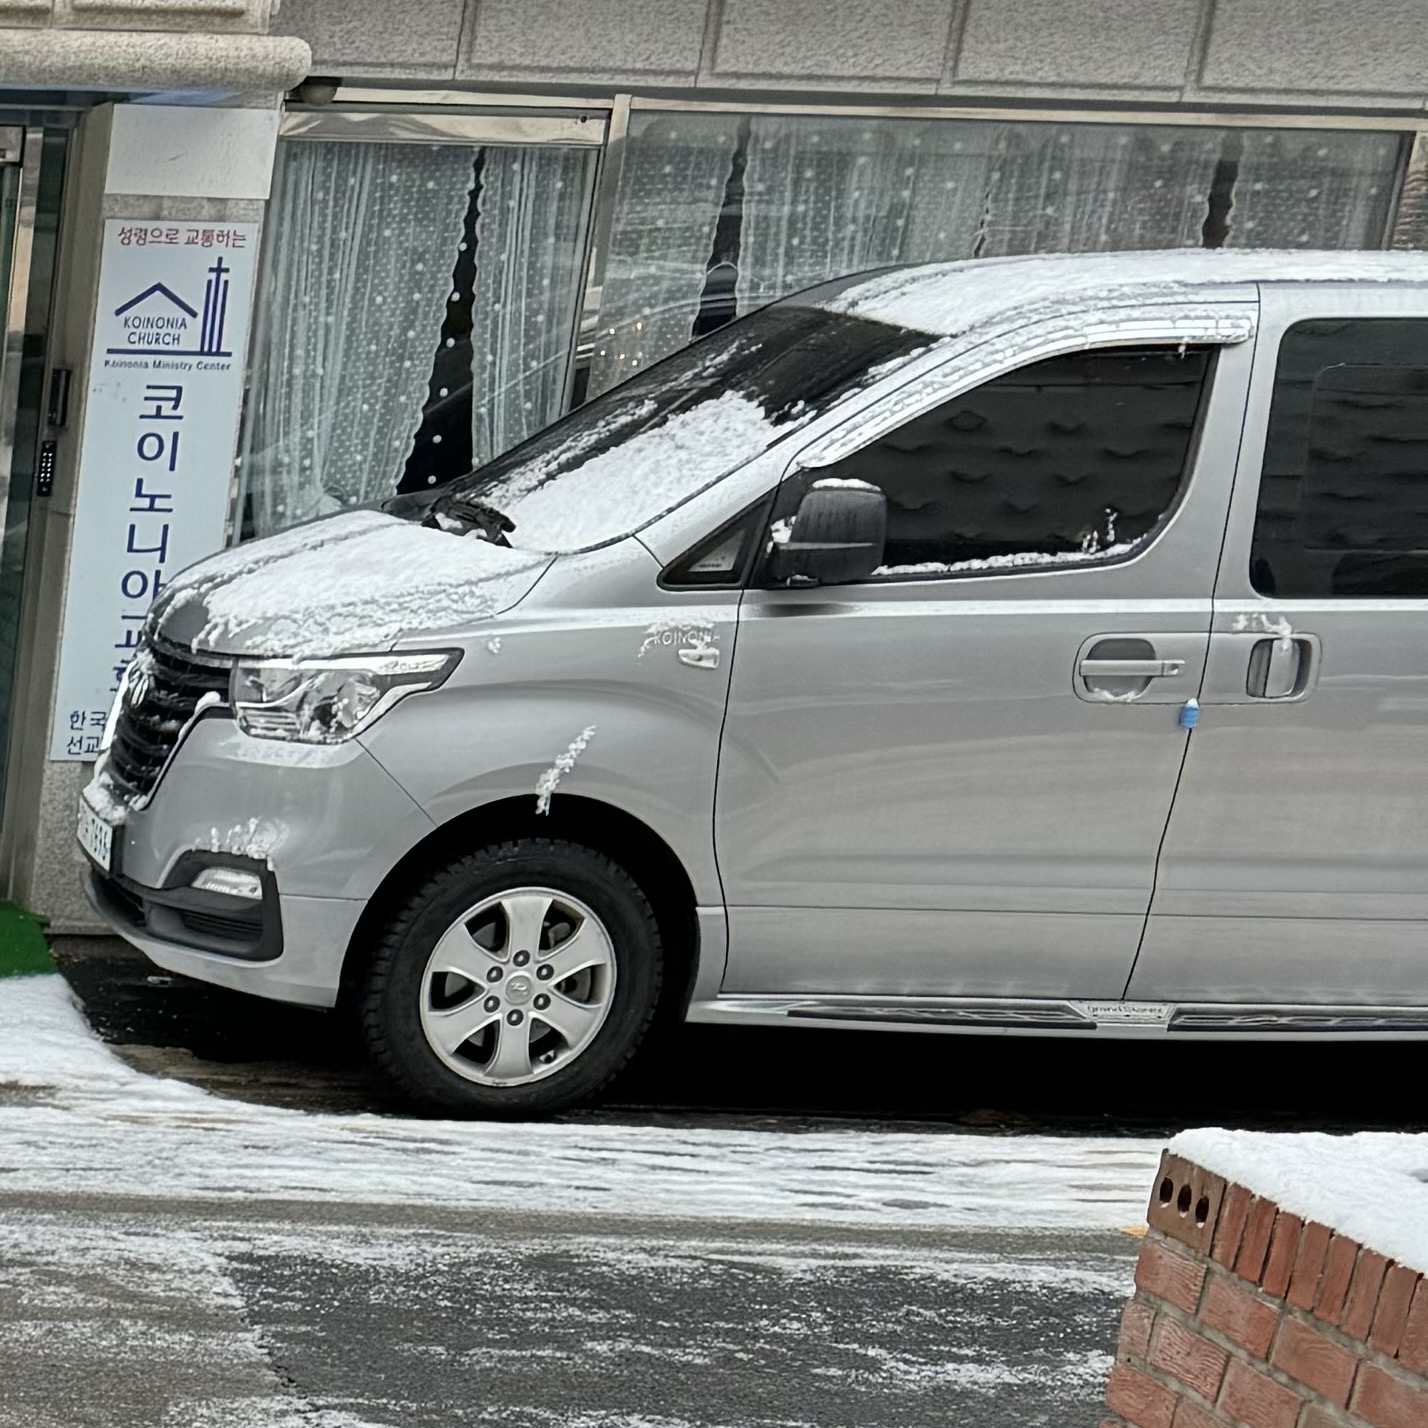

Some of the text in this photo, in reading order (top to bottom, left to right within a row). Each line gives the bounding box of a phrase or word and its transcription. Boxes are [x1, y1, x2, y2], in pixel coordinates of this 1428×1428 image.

[118, 227, 247, 249] 성령으로 교통하는
[123, 316, 187, 330] KOINONIA
[127, 332, 181, 346] CHURCH
[152, 360, 193, 371] Ministry
[196, 361, 231, 371] Center
[654, 631, 720, 645] KOINO
